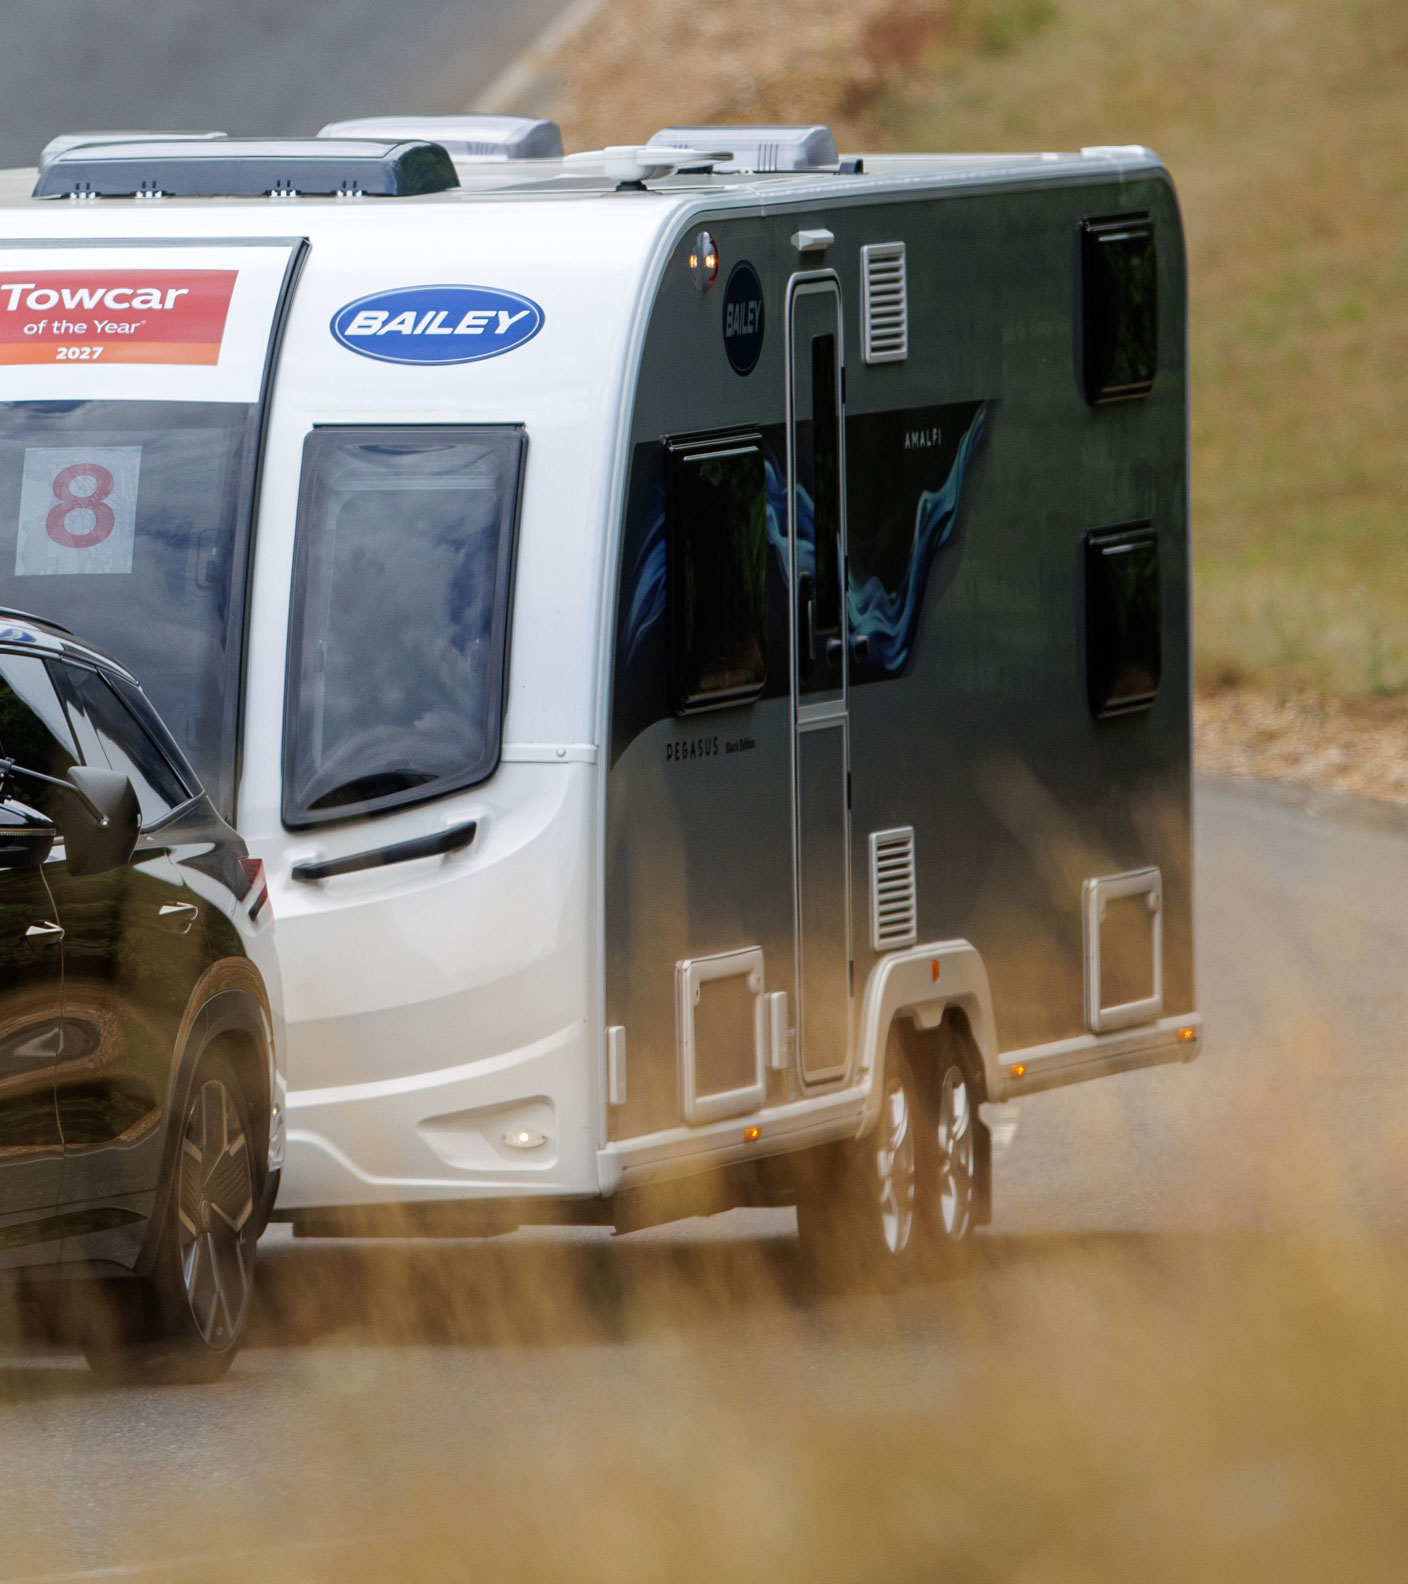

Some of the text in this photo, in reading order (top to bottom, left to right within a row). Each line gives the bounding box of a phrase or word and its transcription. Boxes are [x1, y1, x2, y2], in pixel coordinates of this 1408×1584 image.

[0, 283, 189, 311] Towcar
[23, 319, 141, 335] of the Year
[344, 310, 531, 335] BAILEY
[725, 301, 762, 338] BAILEY
[56, 346, 103, 360] 2027
[904, 428, 942, 449] AMALFI
[45, 463, 115, 548] 8
[666, 737, 719, 762] PEGASUS
